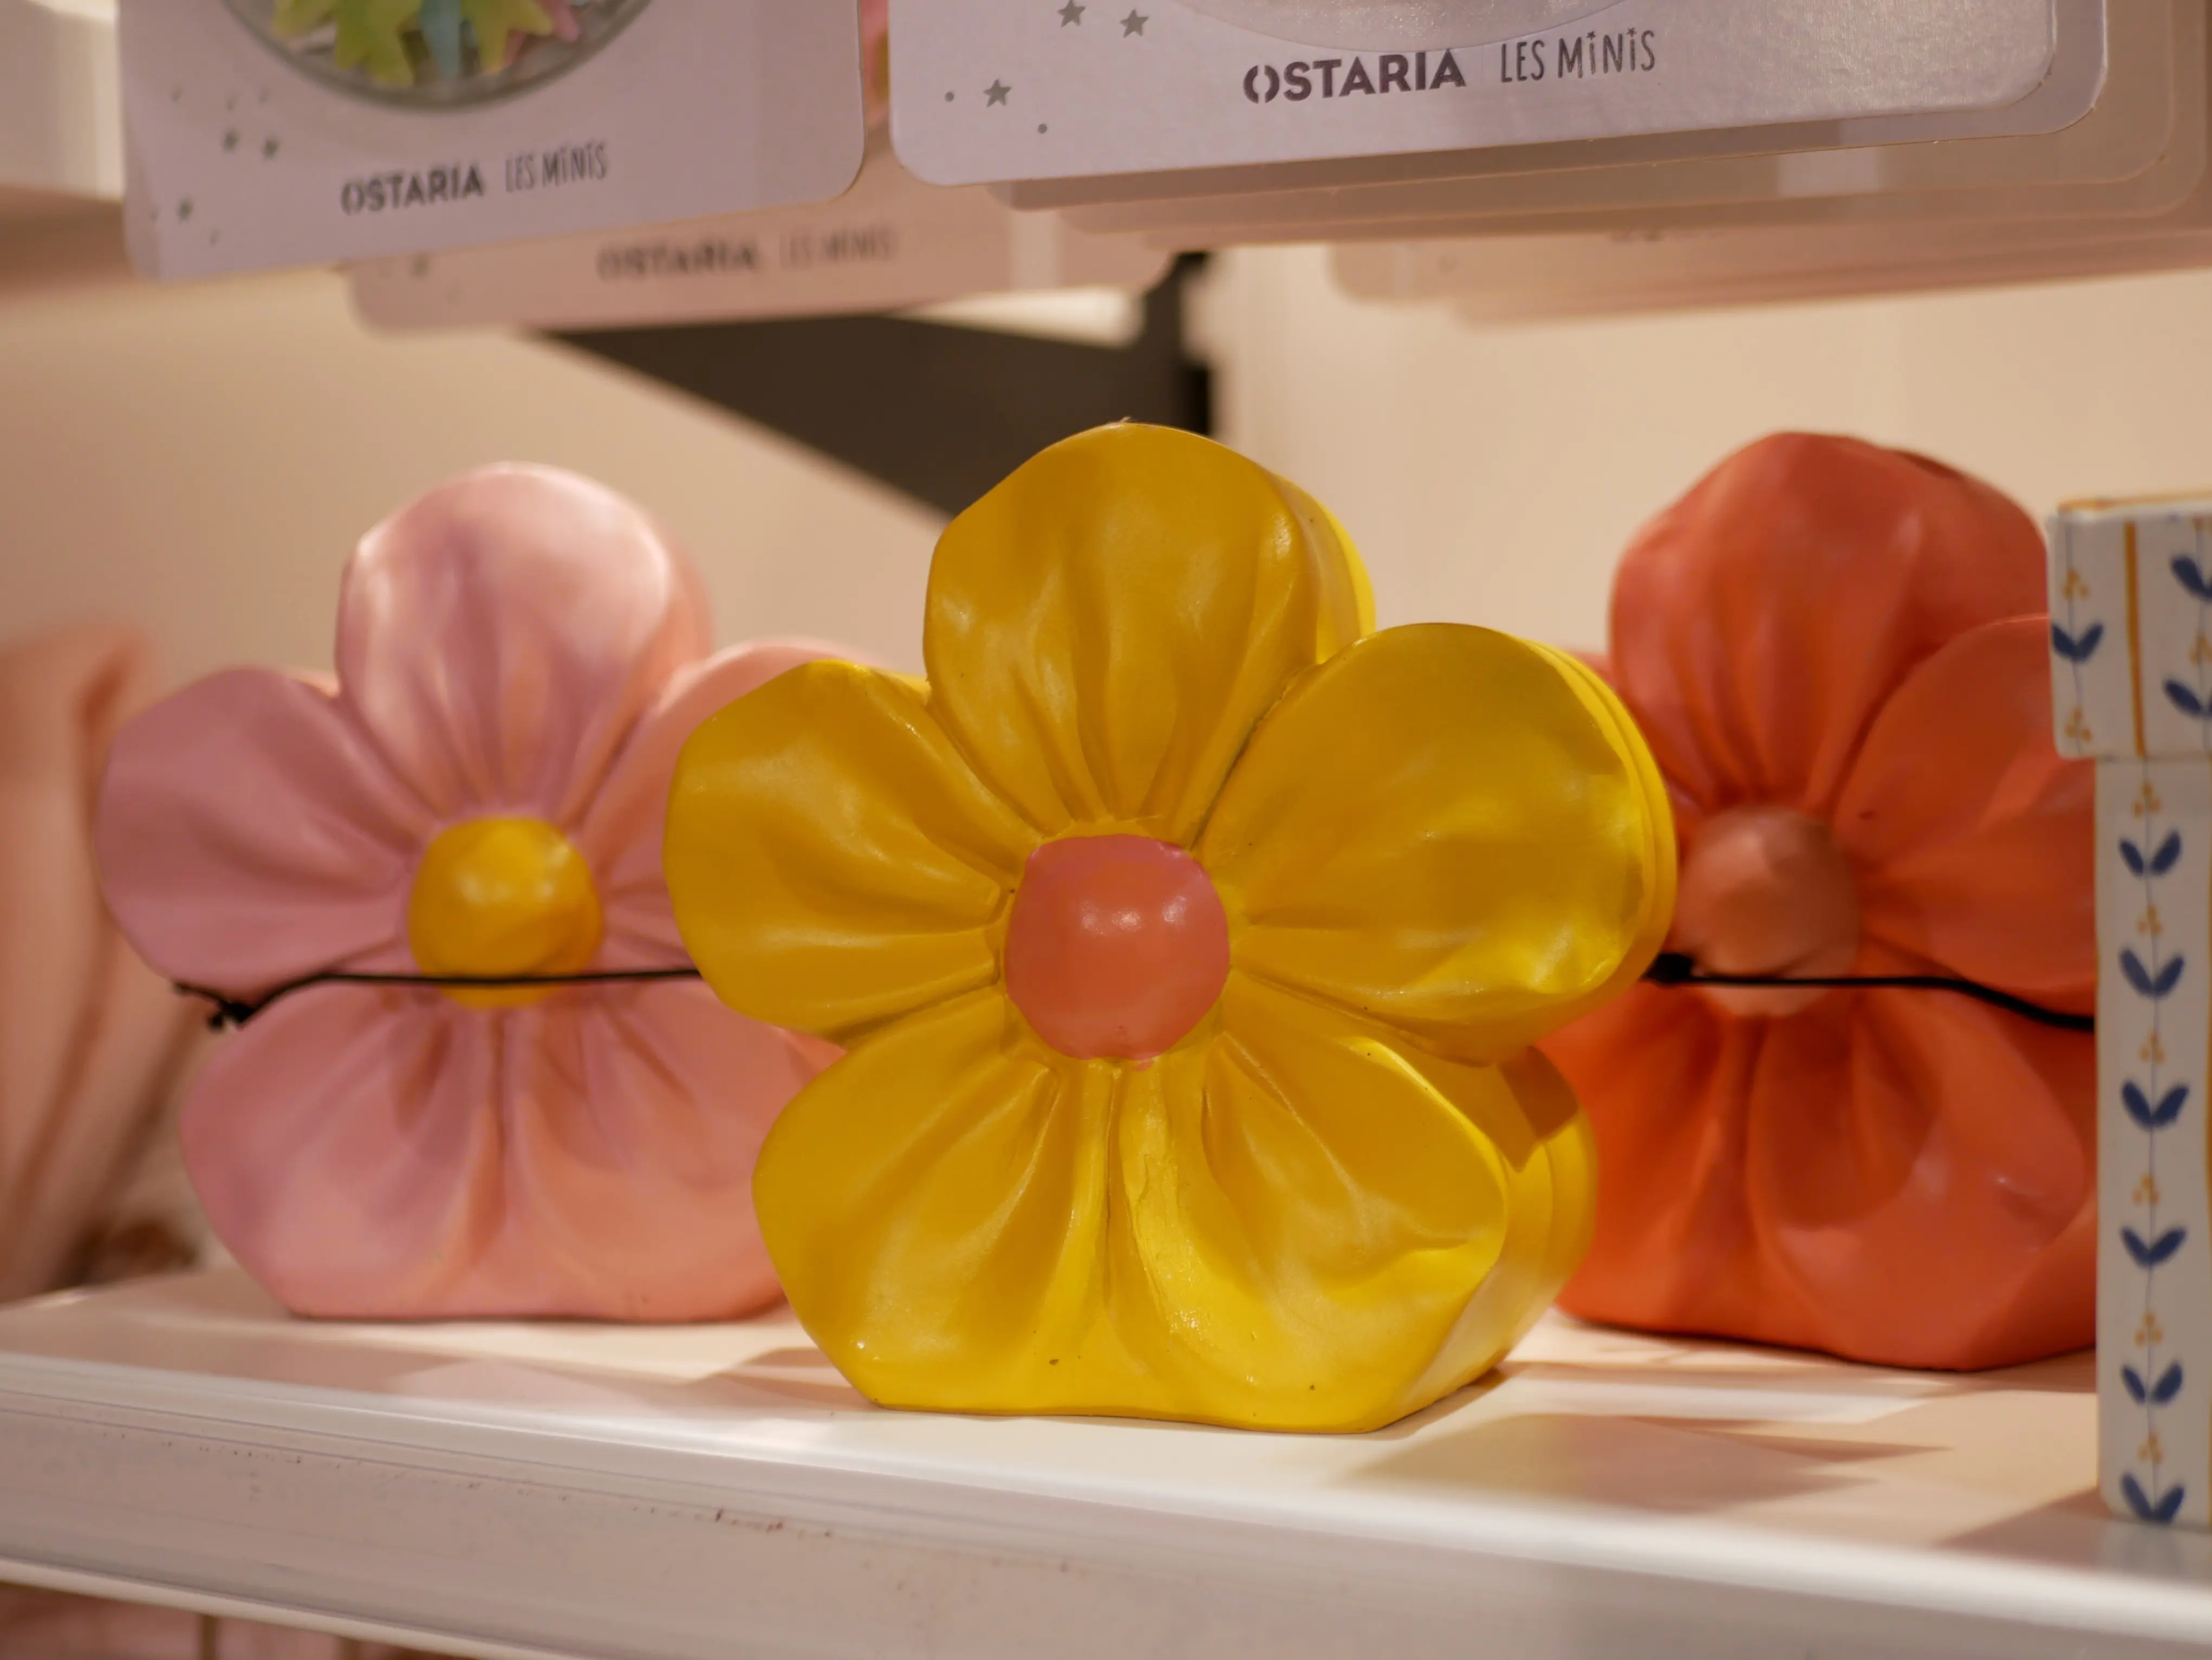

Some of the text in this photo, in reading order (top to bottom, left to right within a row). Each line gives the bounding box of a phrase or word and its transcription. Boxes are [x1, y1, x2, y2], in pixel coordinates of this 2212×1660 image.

[1243, 48, 1466, 103] OSTARIA
[1501, 40, 1545, 83] LES
[341, 163, 485, 216] OSTARIA
[505, 154, 536, 192] LES
